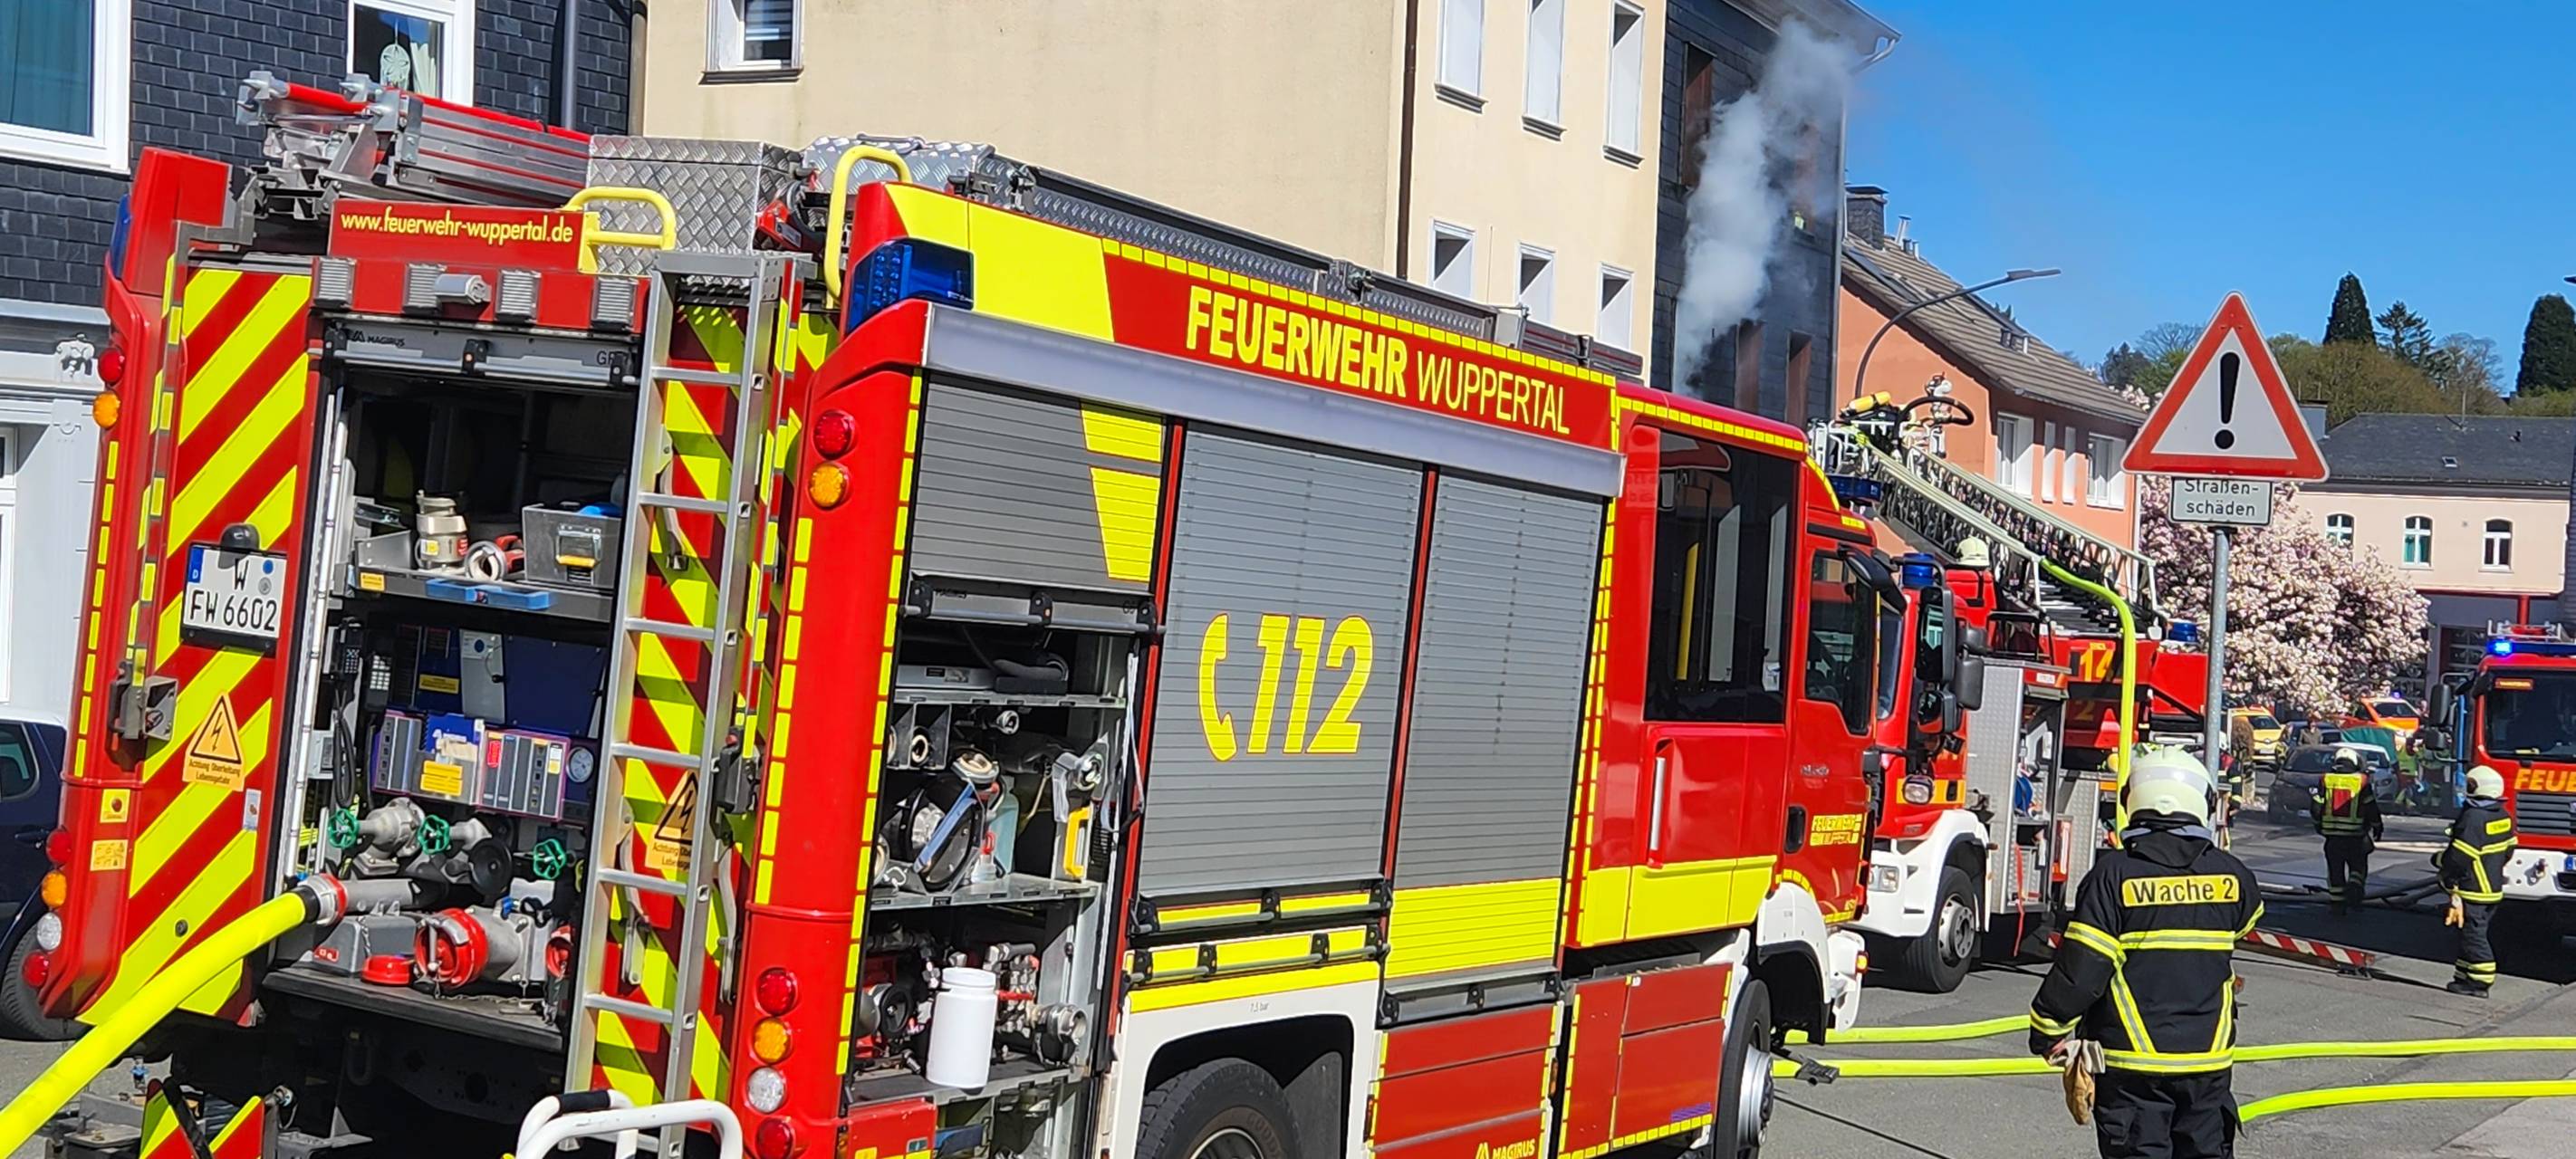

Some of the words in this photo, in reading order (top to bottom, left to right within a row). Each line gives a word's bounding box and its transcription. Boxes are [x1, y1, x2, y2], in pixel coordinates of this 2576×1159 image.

[341, 206, 573, 245] www.feuerwehr-wuppertal.de
[1186, 285, 1407, 398] FEUERWEHR
[1417, 350, 1571, 435] WUPPERTAL
[2185, 479, 2259, 494] Straßen-
[2186, 500, 2255, 516] schäden
[234, 558, 249, 590] W
[190, 589, 218, 623] FW
[223, 595, 278, 631] 6602
[1246, 613, 1373, 753] 112
[2131, 878, 2214, 903] Wache
[2222, 877, 2234, 899] 2
[1493, 1138, 1535, 1159] MAGIRUS
